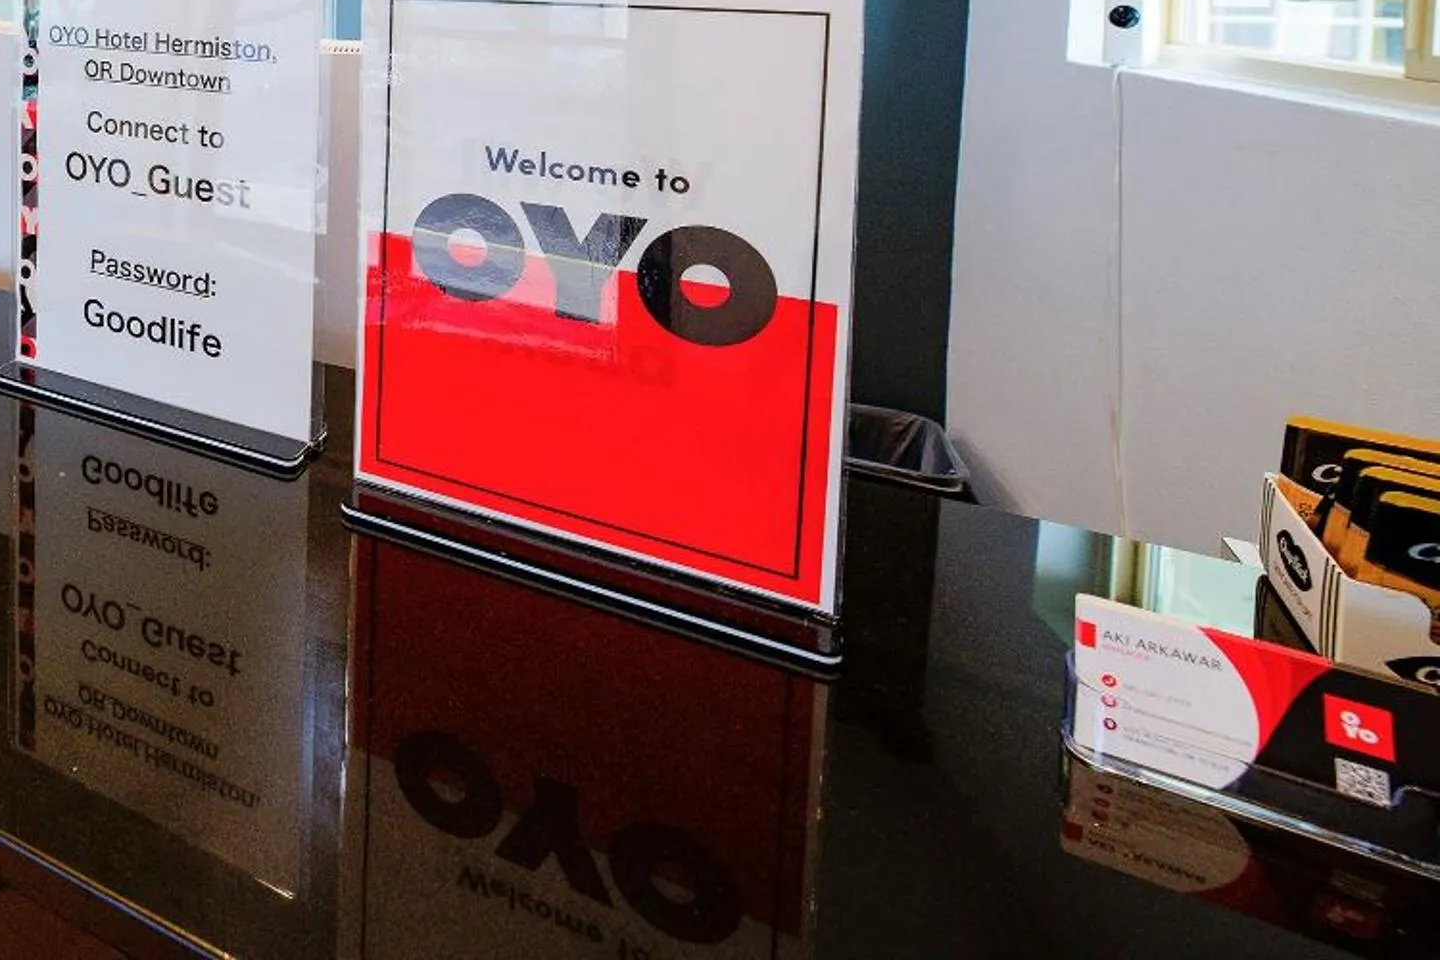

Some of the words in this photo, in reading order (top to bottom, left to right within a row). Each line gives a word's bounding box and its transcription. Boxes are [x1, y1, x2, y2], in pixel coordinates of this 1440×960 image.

[49, 25, 89, 45] OYO
[95, 28, 148, 51] Hotel
[155, 32, 277, 64] Hermiston,
[84, 59, 113, 80] OR
[120, 63, 231, 92] Downtown
[87, 111, 190, 145] Connect
[198, 125, 225, 149] to
[66, 151, 251, 209] OYO_Guest
[485, 145, 640, 188] Welcome
[655, 168, 690, 195] to
[90, 249, 216, 298] Password:
[412, 193, 778, 347] OYO
[83, 299, 222, 358] Goodlife
